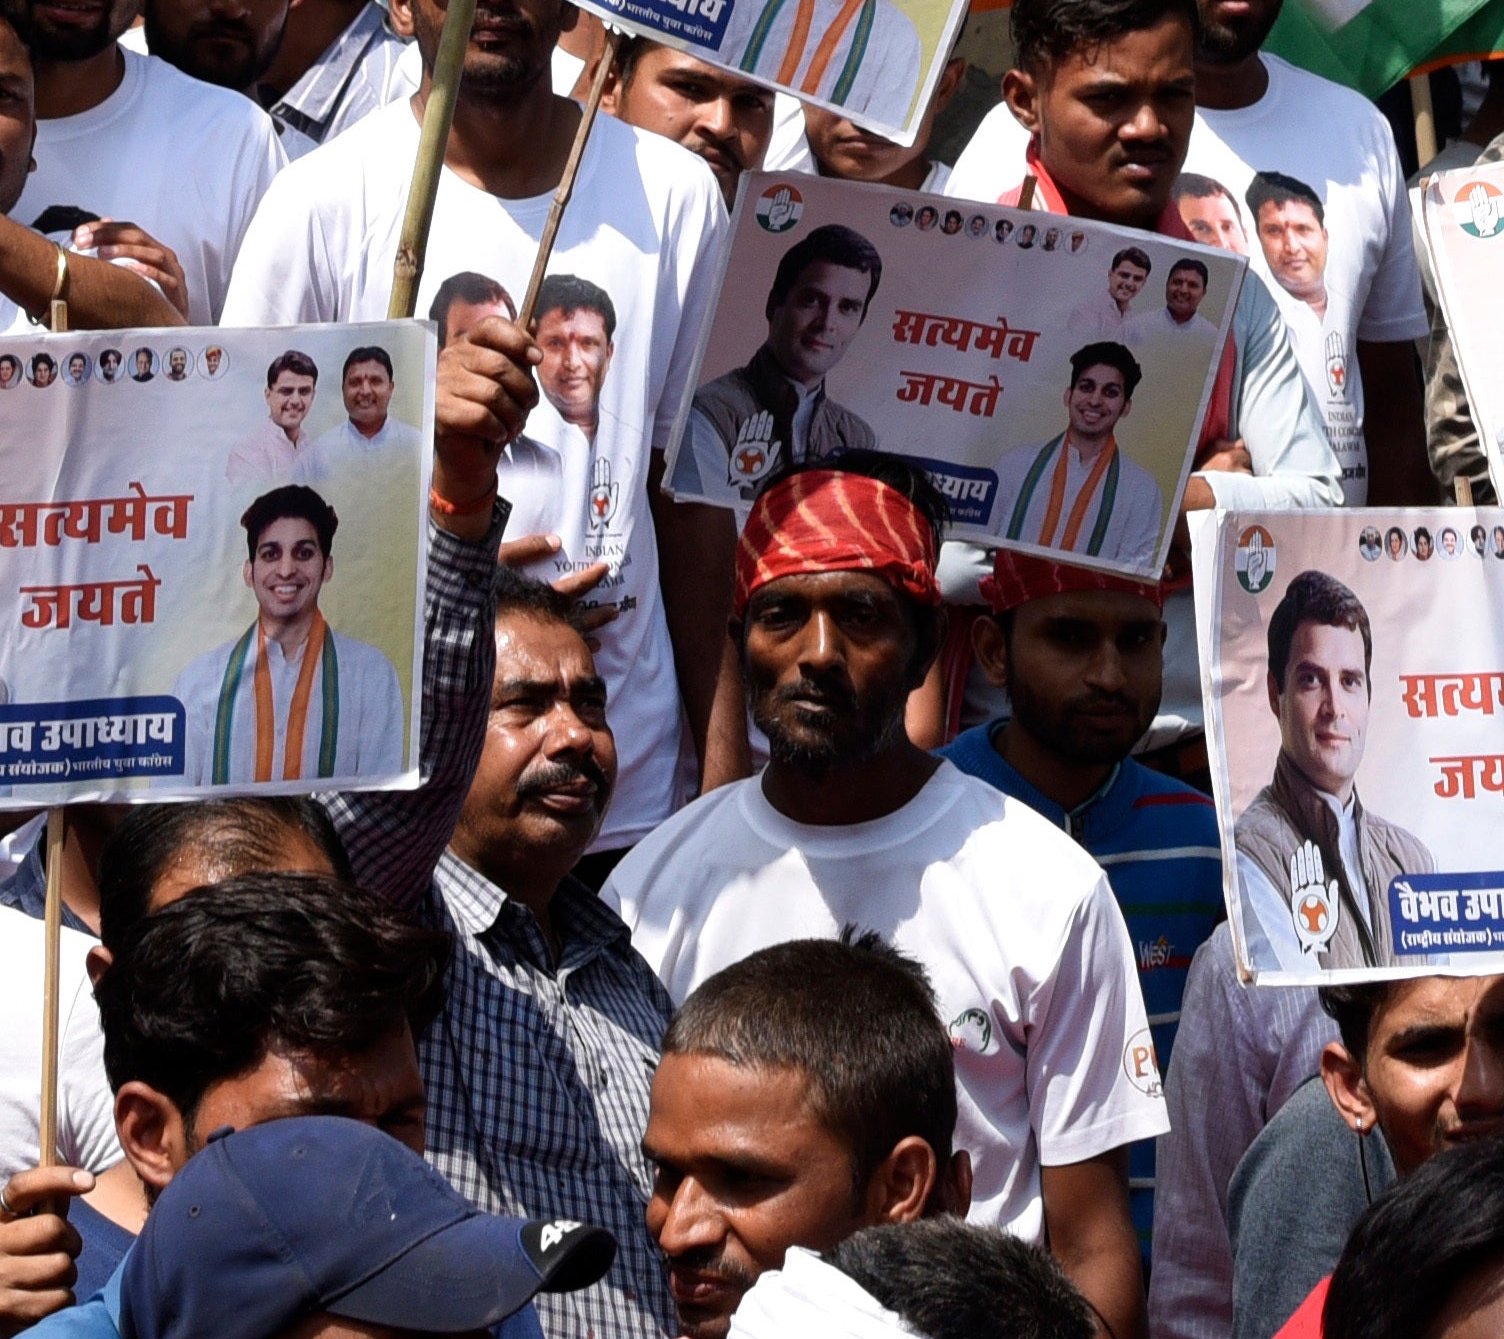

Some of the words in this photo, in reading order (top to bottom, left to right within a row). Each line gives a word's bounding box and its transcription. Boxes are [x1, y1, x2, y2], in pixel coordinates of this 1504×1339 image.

[891, 308, 1041, 363] सत्यमेव
[895, 370, 1005, 418] जयते
[19, 563, 162, 631] जयते
[39, 712, 177, 752] उपाध्याय
[1393, 880, 1459, 923] वैभव
[1138, 939, 1175, 969] WEST
